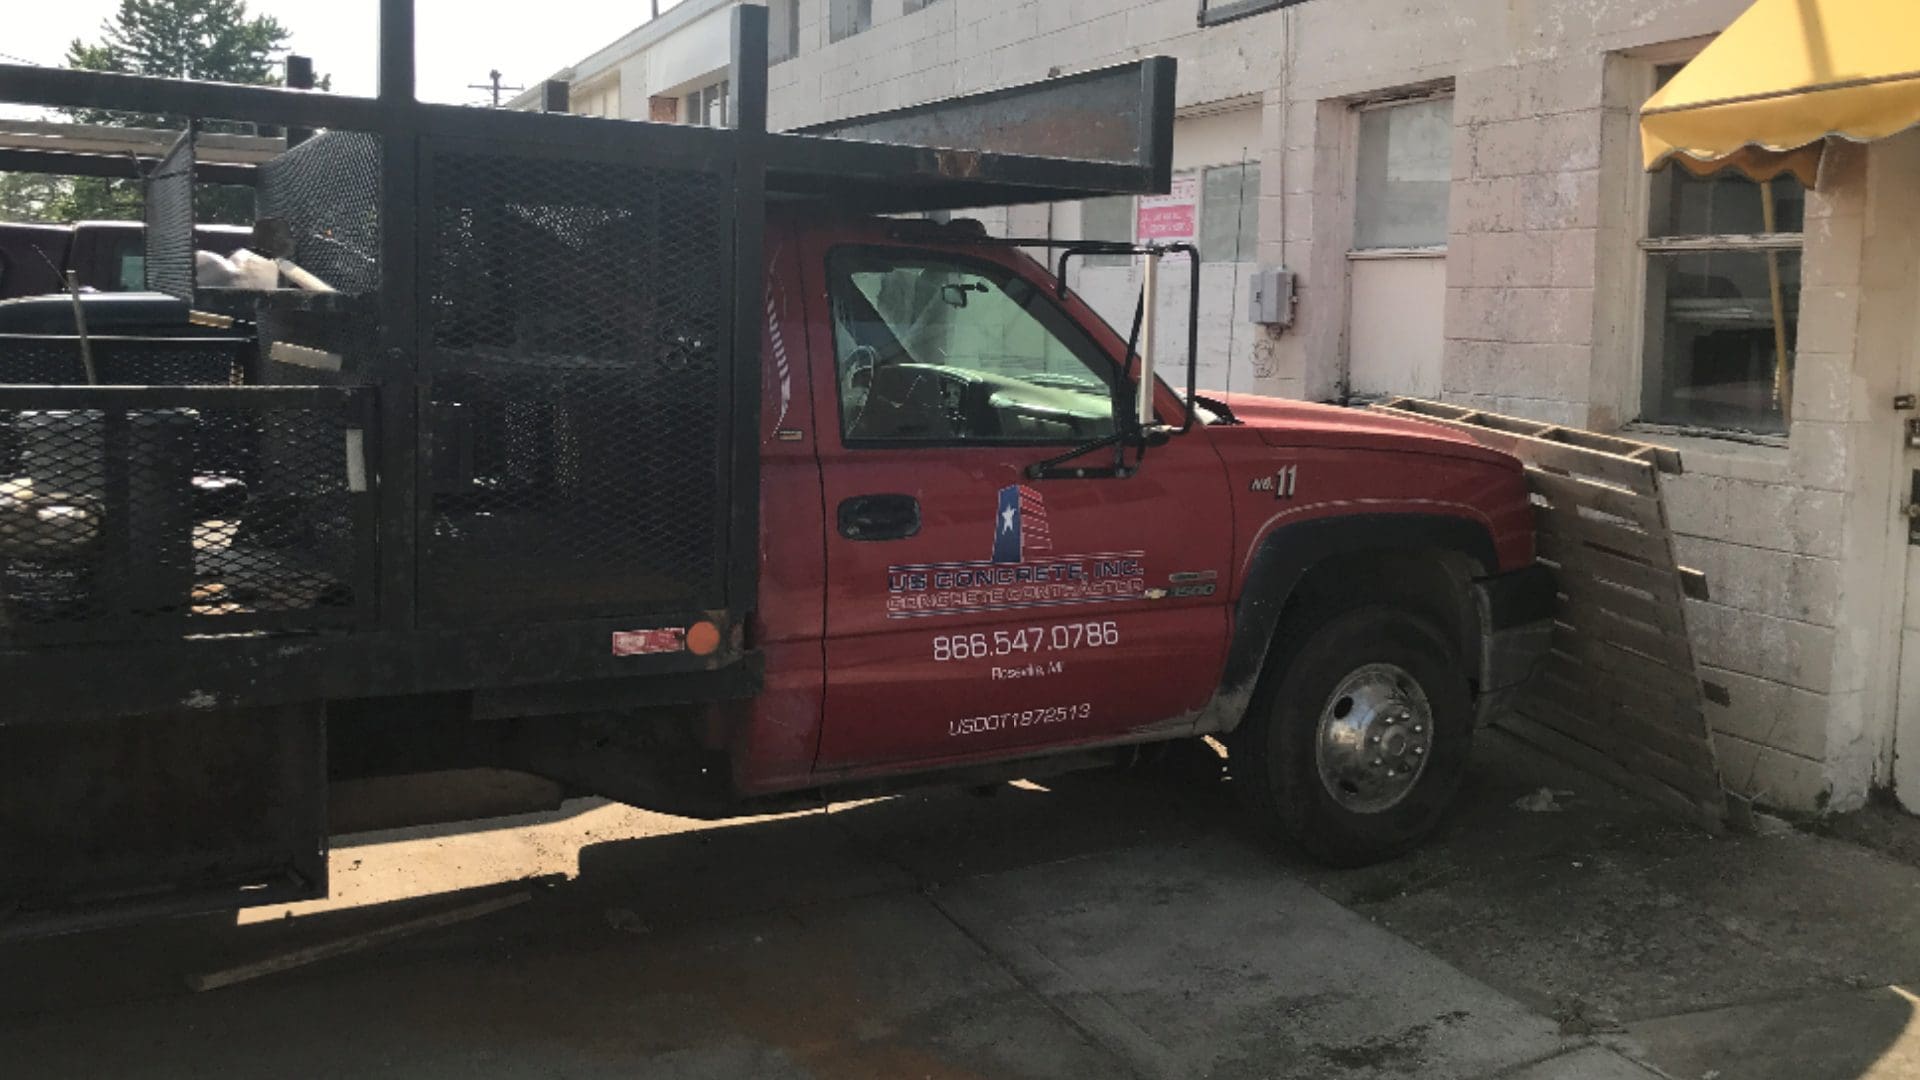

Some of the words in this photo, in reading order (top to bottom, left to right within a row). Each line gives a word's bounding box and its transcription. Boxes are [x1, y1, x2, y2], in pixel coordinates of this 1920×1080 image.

[1275, 463, 1298, 498] 11
[888, 573, 927, 592] US
[934, 562, 1089, 589] CONCRETE,
[1094, 558, 1145, 578] INC.
[887, 589, 1004, 612] CONCRETE
[932, 621, 1119, 661] 866.547.0786
[949, 702, 1092, 737] USDOT1872513
